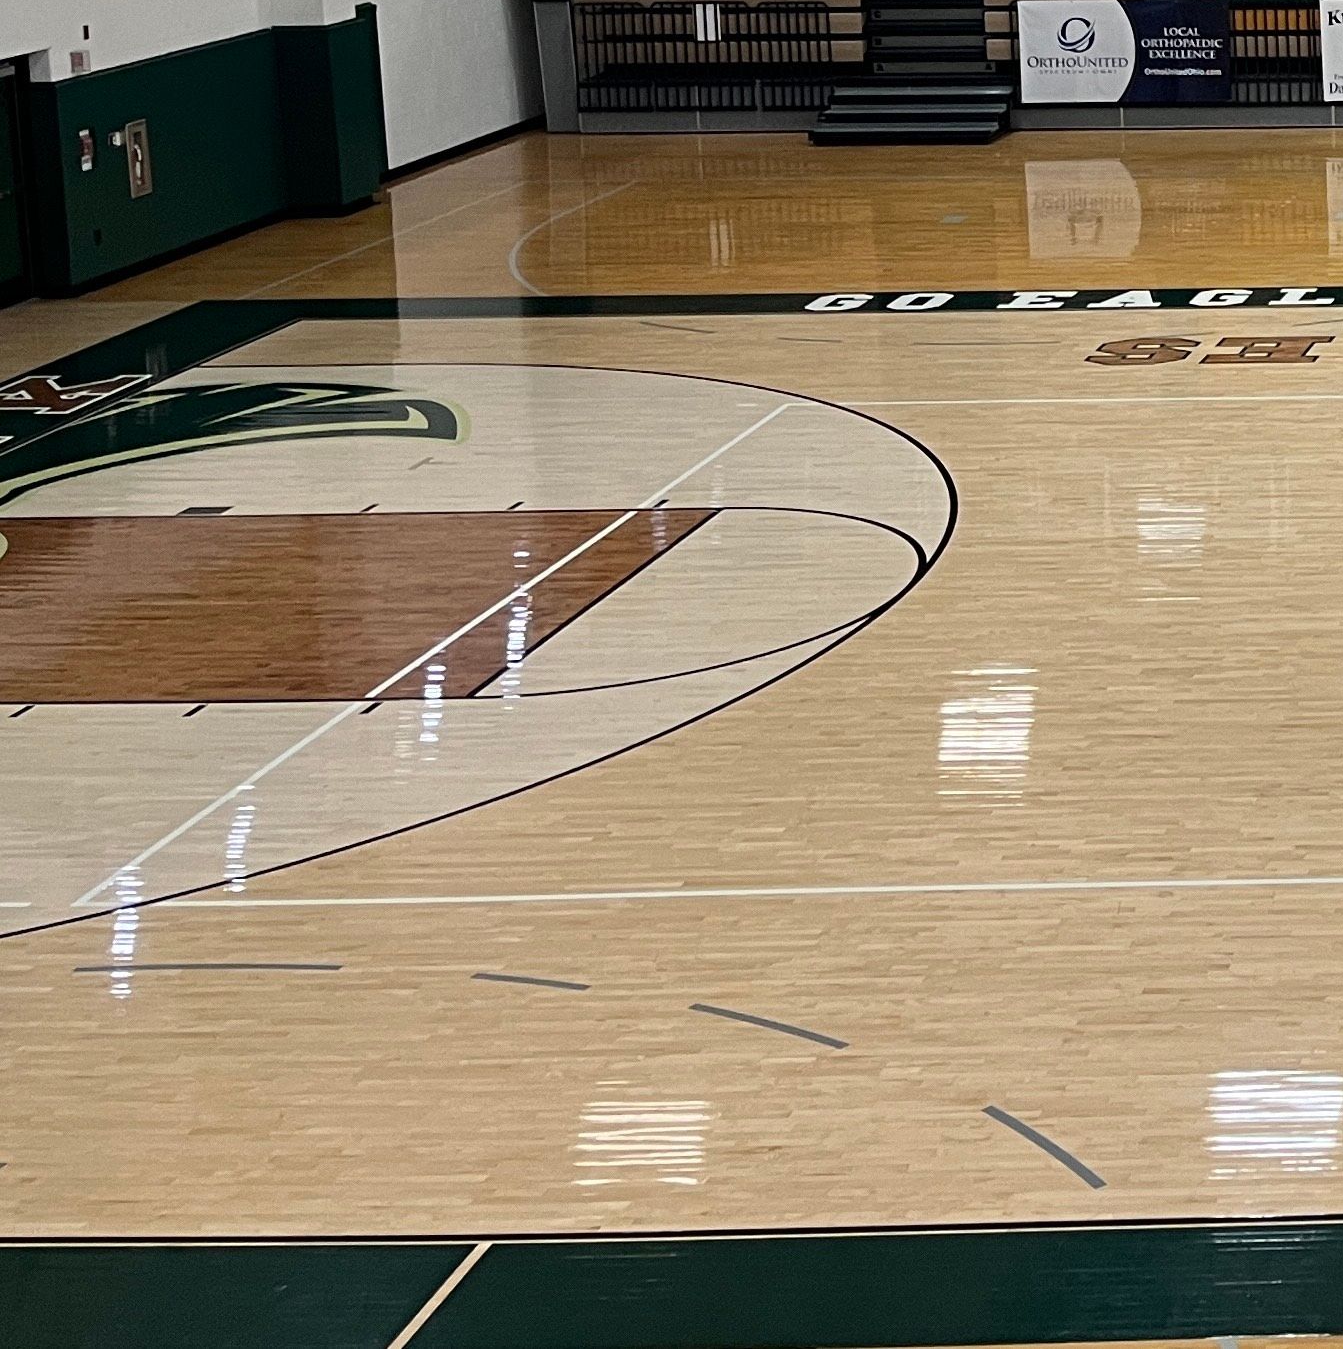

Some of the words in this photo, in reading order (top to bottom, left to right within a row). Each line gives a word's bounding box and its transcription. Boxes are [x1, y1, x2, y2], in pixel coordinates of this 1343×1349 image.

[1163, 27, 1200, 37] LOCAL
[1149, 49, 1216, 60] EXCELLENCE
[804, 292, 954, 312] GO
